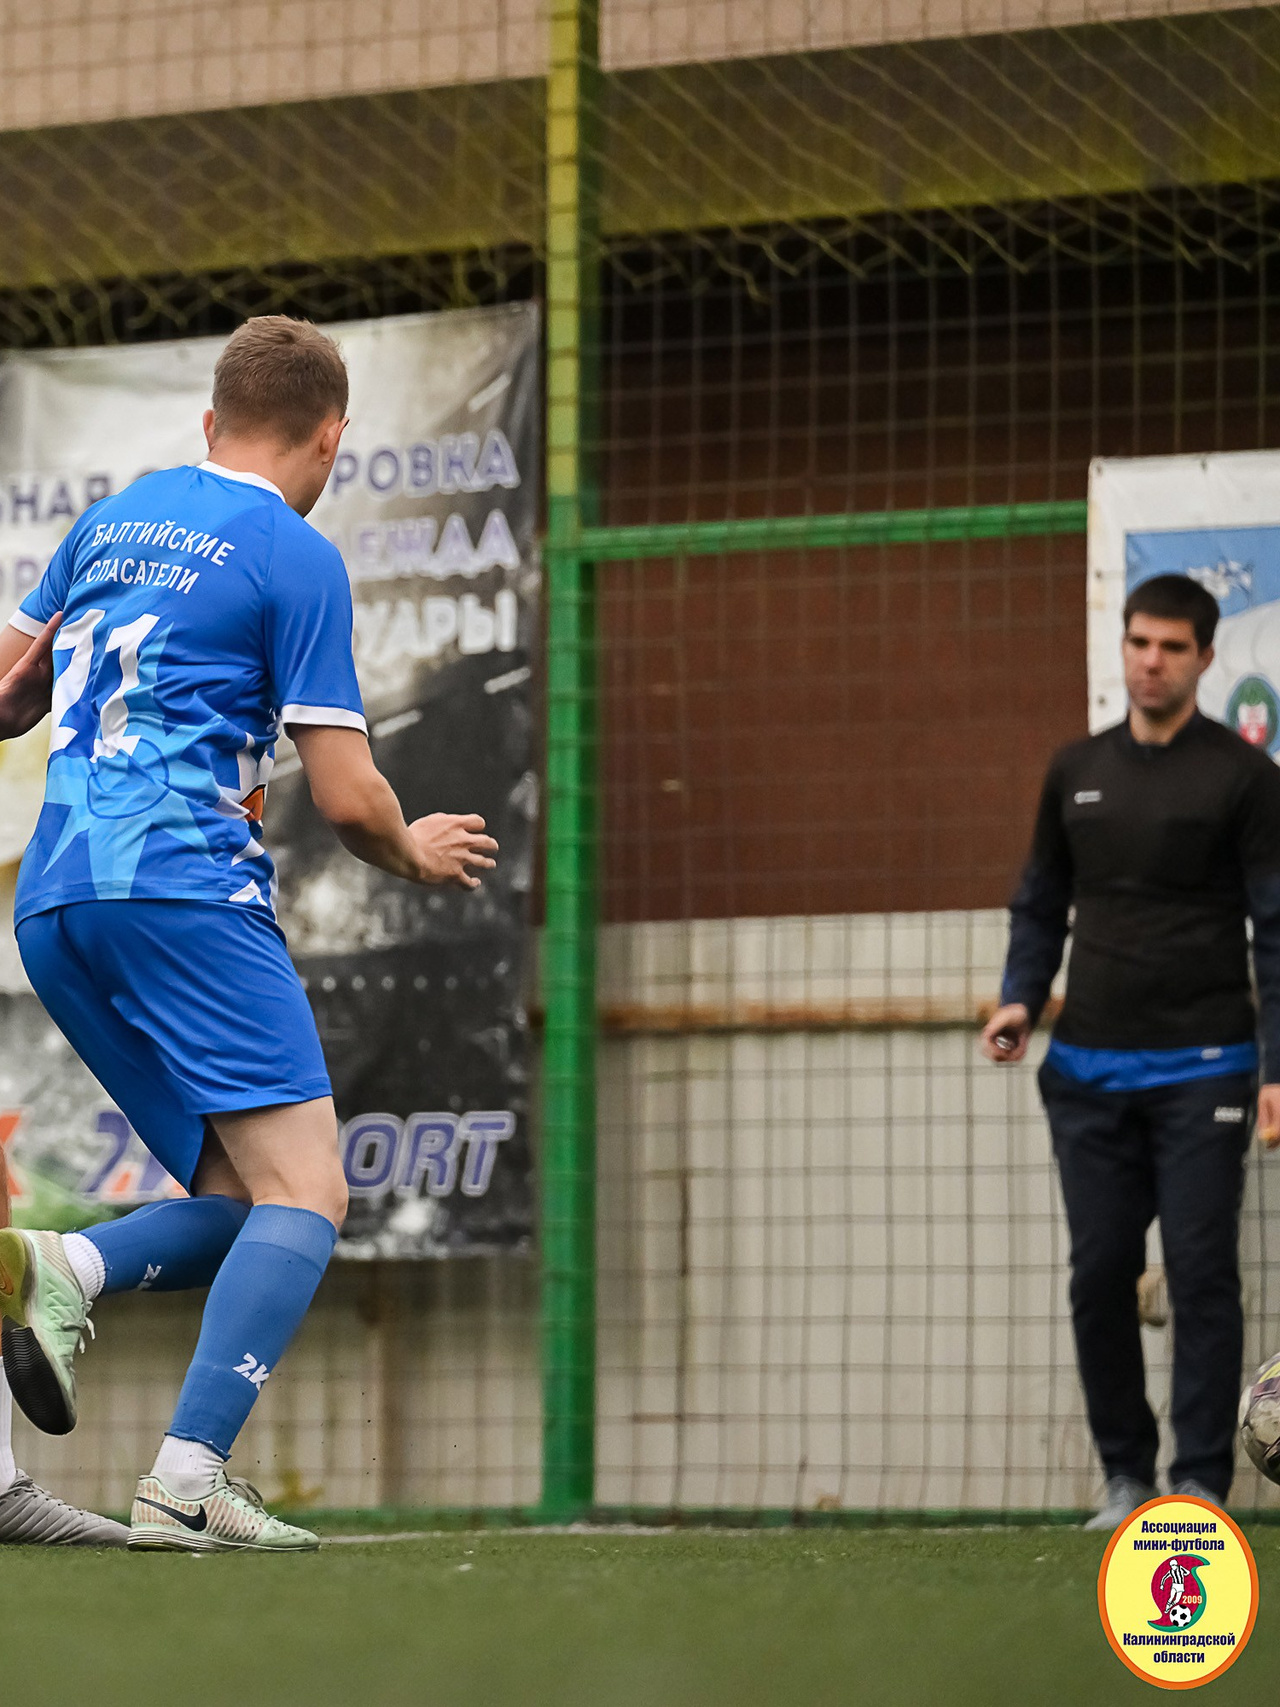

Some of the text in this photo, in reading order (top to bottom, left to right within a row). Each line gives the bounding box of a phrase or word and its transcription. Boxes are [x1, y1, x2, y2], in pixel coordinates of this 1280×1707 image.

[91, 520, 236, 567] БАЛТИЙСКИЕ
[86, 557, 200, 595] СПАСАТЕЛИ
[233, 1353, 270, 1391] 2K
